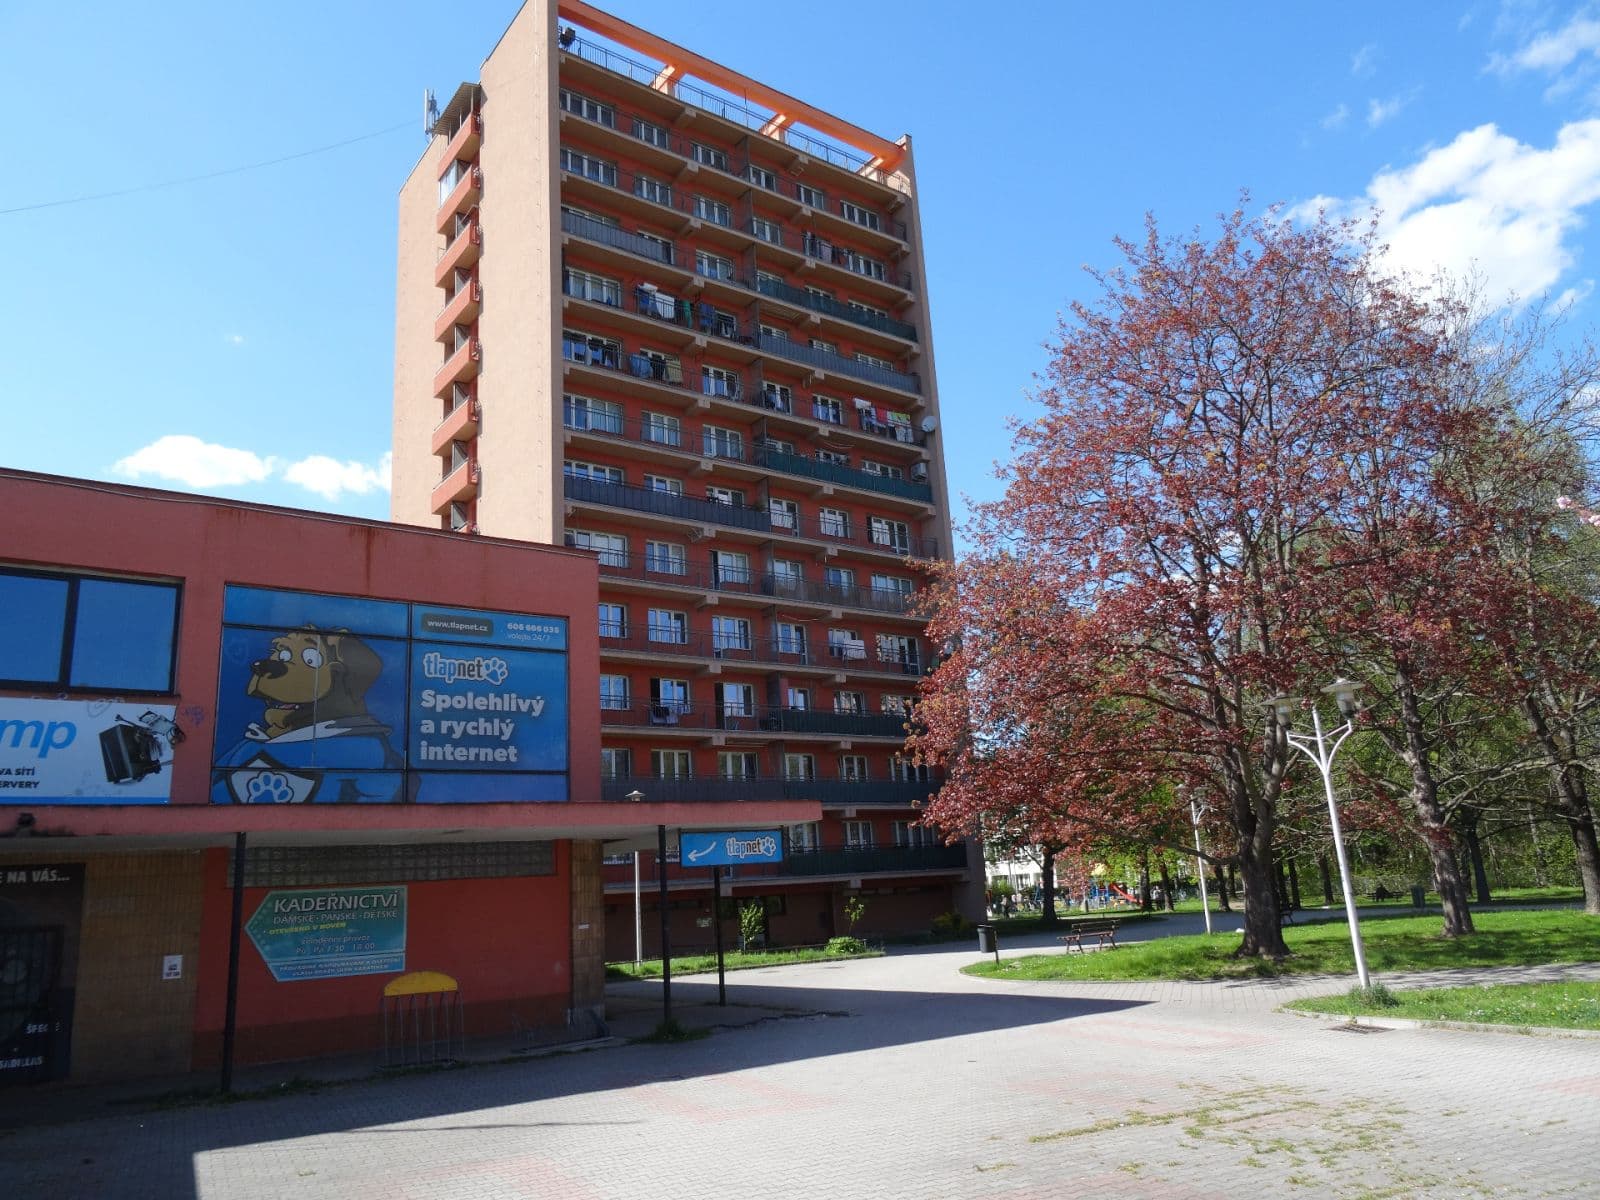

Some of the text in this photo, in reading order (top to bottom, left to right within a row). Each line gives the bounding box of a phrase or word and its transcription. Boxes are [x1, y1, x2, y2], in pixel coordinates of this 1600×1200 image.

[427, 618, 488, 632] www.tlapnet.cz
[423, 652, 484, 683] tlapnet
[420, 689, 545, 717] Spolehlivý
[420, 717, 515, 741] a rychlý
[420, 740, 518, 762] internet
[726, 837, 762, 859] tlapnet
[7, 871, 26, 883] NA
[274, 890, 399, 913] KADEŘNICTVÍ
